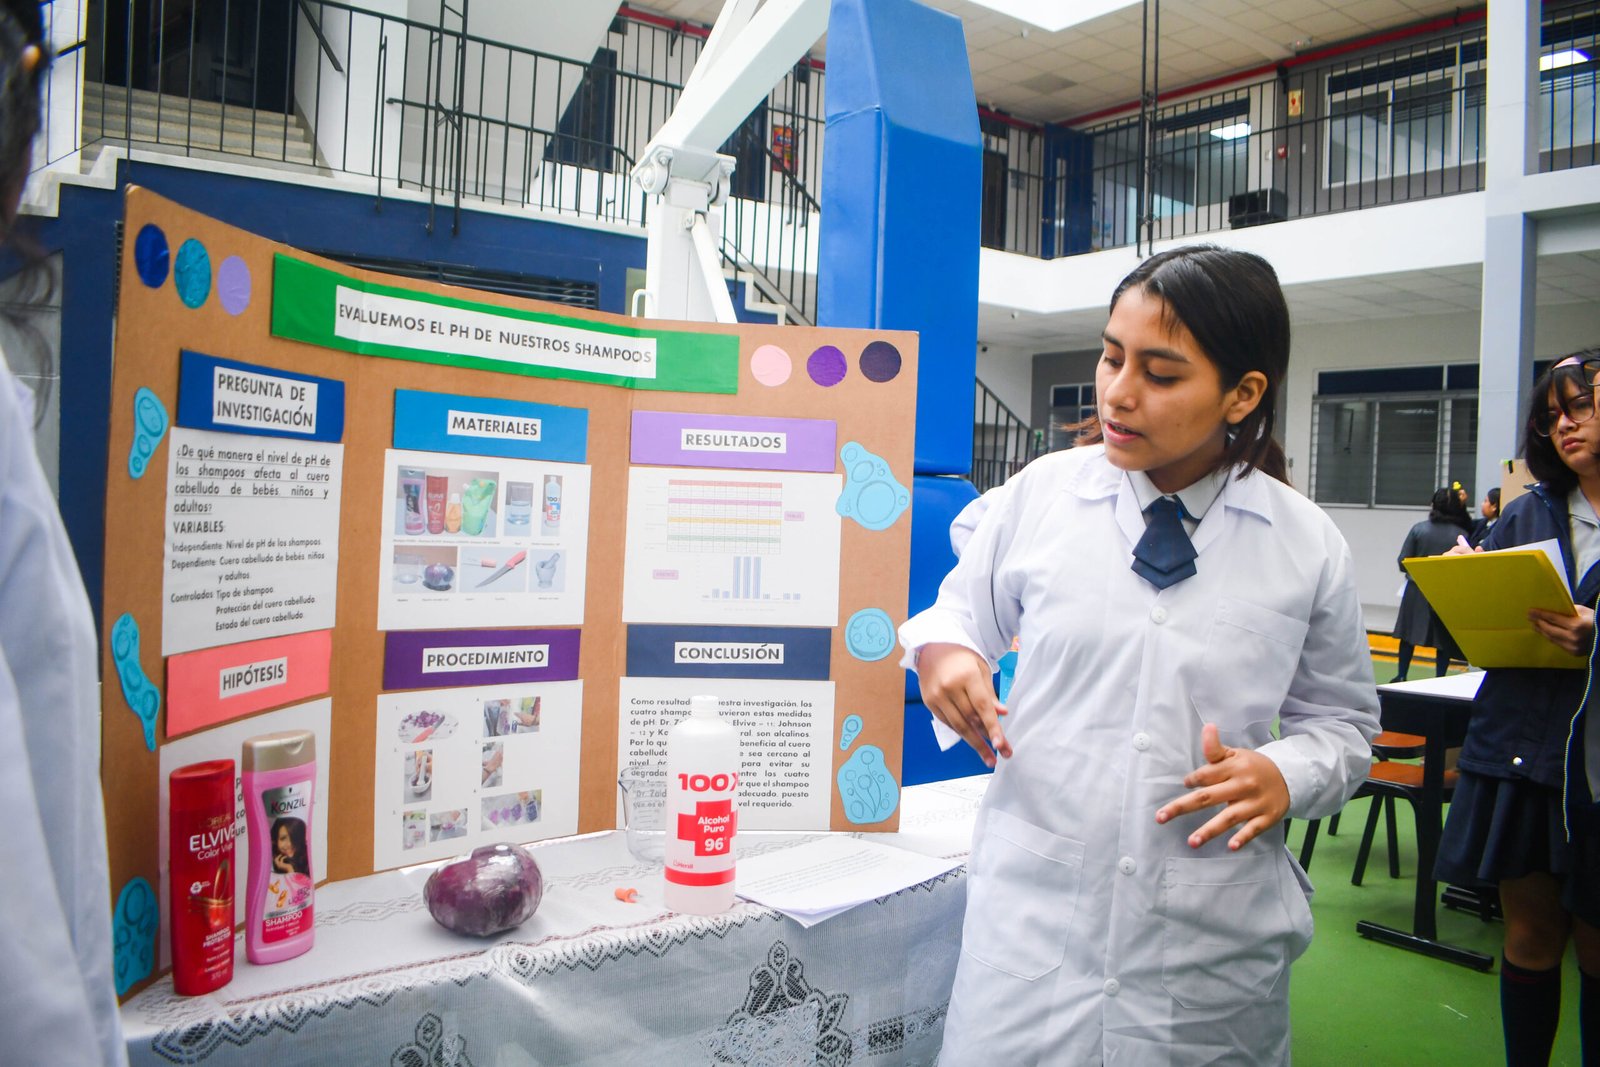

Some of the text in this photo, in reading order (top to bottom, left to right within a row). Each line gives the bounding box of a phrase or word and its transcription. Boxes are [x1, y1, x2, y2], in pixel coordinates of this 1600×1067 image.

[339, 303, 652, 363] EVALUEMOS EL PH DE NUESTROS SHAMPOOS
[218, 373, 306, 402] PREGUNTA DE
[217, 400, 313, 427] INVESTIGACIÓN
[452, 416, 538, 436] MATERIALES
[685, 433, 782, 449] RESULTADOS
[176, 444, 331, 467] ¿De qué manera el nivel de pH de
[176, 461, 330, 482] los shampoos afecta al cuero
[175, 480, 220, 495] cabelludo
[230, 483, 242, 495] de
[291, 485, 314, 496] niños
[323, 488, 329, 500] y
[174, 499, 212, 513] adultos?
[226, 539, 244, 549] Nivel
[245, 539, 254, 548] de
[256, 538, 266, 550] pH
[267, 538, 275, 548] de
[277, 538, 286, 547] los
[219, 555, 240, 566] Cuero
[241, 554, 274, 564] cabelludo
[275, 553, 284, 562] de
[218, 575, 223, 583] y
[216, 589, 230, 600] Tipo
[232, 588, 241, 597] de
[216, 602, 251, 615] Protección
[252, 600, 263, 611] del
[264, 601, 283, 609] cuero
[215, 618, 238, 631] Estado
[240, 616, 251, 627] del
[252, 617, 271, 626] cuero
[426, 650, 545, 667] PROCEDIMIENTO
[678, 643, 780, 660] CONCLUSIÓN
[223, 664, 284, 691] HIPÓTESIS
[630, 698, 655, 706] Como
[656, 698, 692, 706] resultad
[800, 700, 812, 708] los
[630, 707, 657, 715] cuatro
[660, 707, 692, 717] shampo
[718, 709, 750, 717] uvieron
[777, 710, 812, 718] medidas
[630, 718, 641, 726] de
[732, 719, 756, 727] Elvive
[778, 720, 812, 728] Johnson
[656, 740, 667, 748] qu
[803, 750, 811, 758] al
[741, 761, 761, 769] para
[746, 781, 761, 789] que
[772, 780, 810, 789] shampoo
[650, 789, 667, 798] Zaid
[781, 791, 809, 799] puesto
[270, 798, 306, 815] KONZIL
[697, 815, 730, 825] Alcohol
[703, 825, 725, 833] Puro
[197, 847, 220, 860] Color
[265, 910, 303, 926] SHAMPOO
